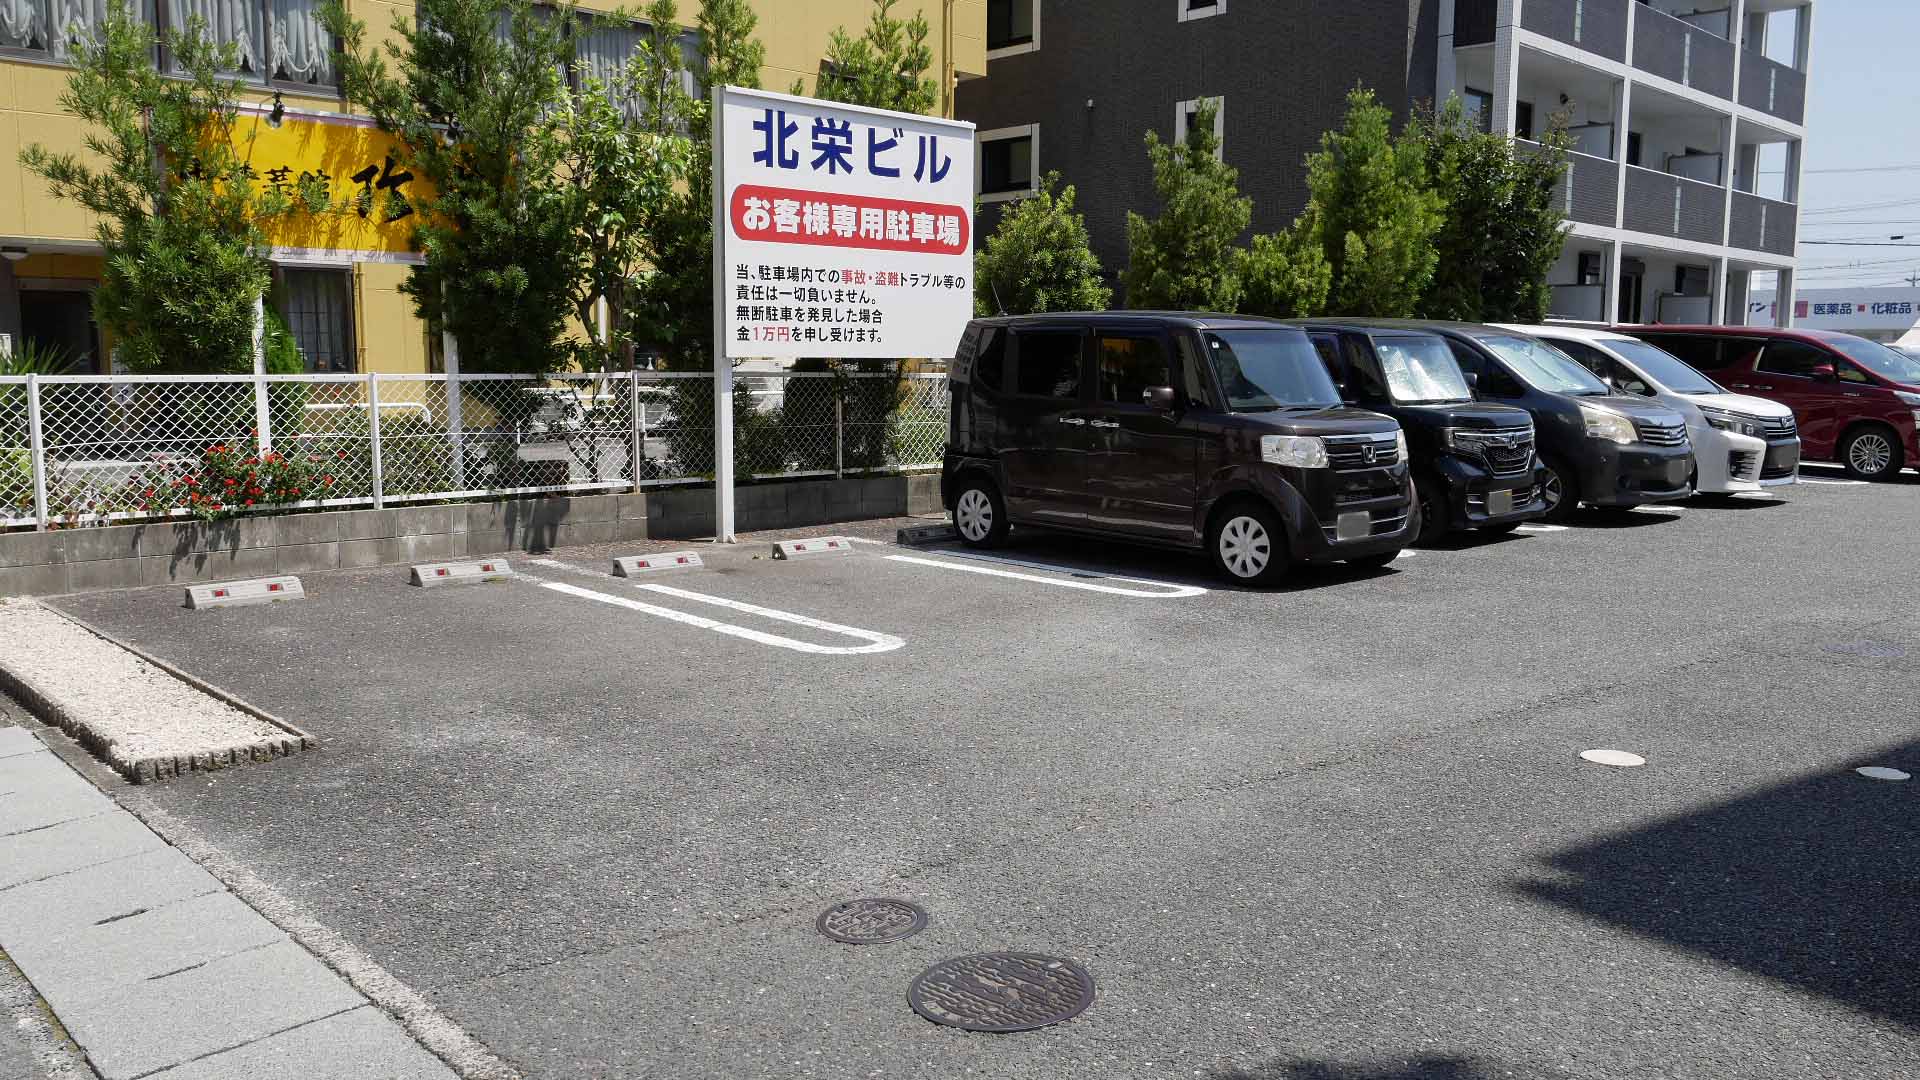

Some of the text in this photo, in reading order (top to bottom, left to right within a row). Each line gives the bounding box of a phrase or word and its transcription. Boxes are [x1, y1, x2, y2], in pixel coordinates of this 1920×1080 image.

[753, 109, 952, 183] 北栄ビル
[742, 196, 960, 246] お客様専用駐車場
[736, 285, 876, 305] 責任は一切負いません。
[736, 305, 883, 324] 無断駐車を発見した場合
[1813, 302, 1853, 316] 医薬品
[1871, 302, 1912, 316] 化粧品
